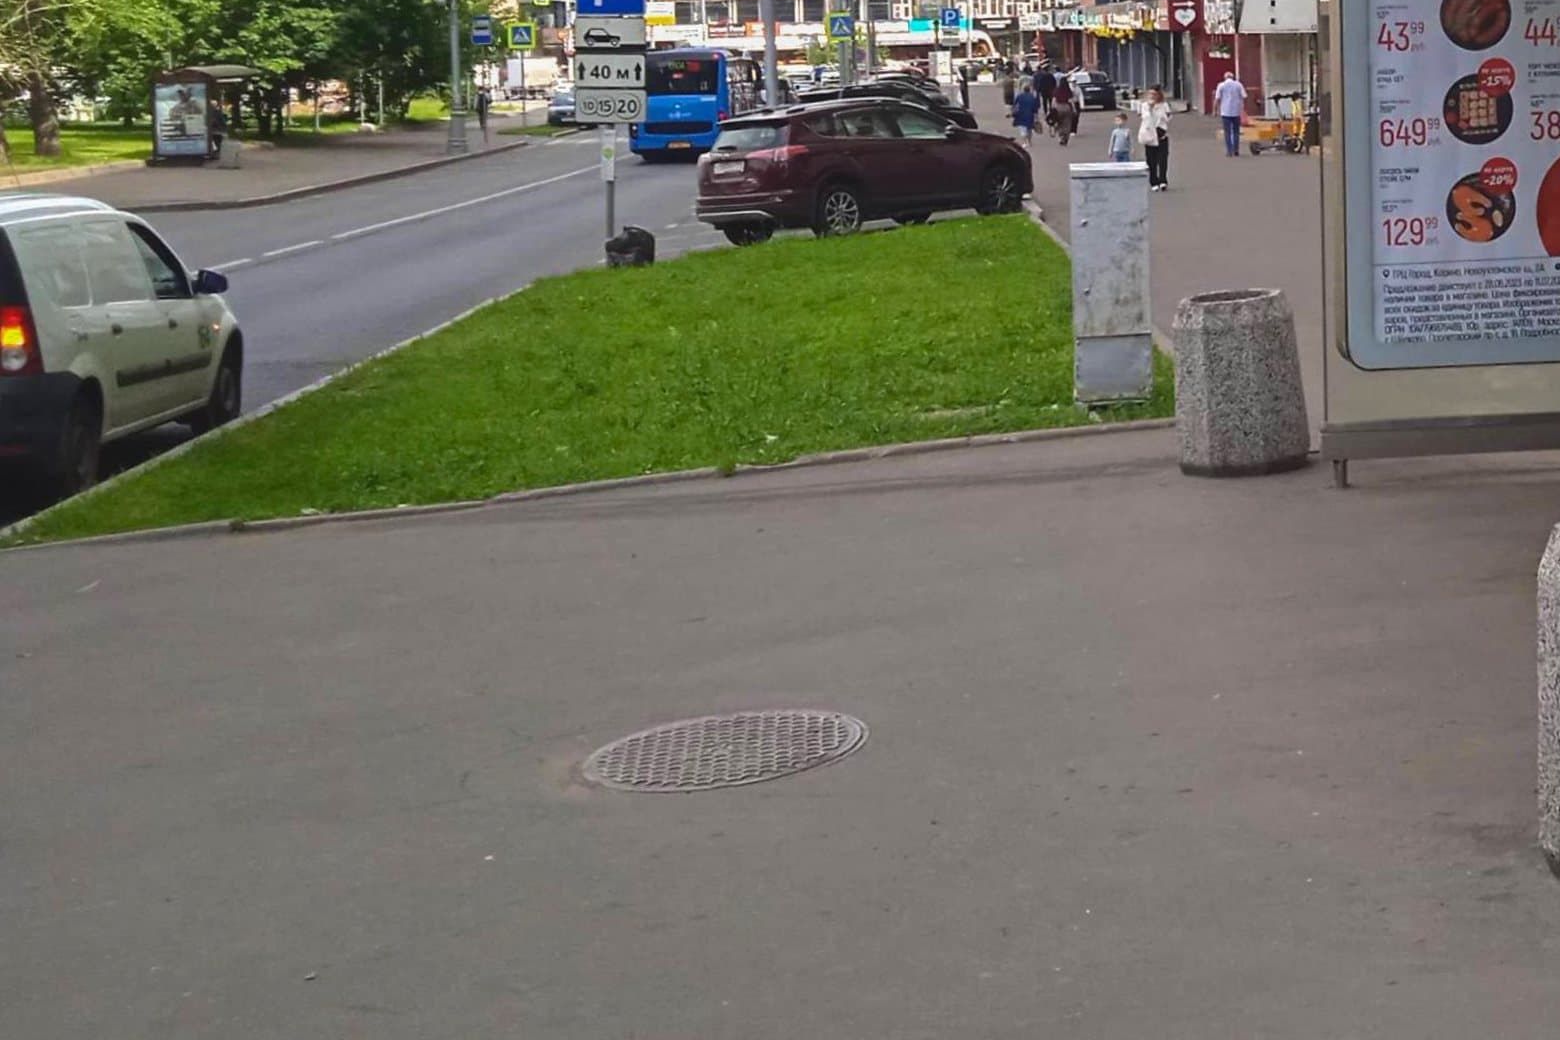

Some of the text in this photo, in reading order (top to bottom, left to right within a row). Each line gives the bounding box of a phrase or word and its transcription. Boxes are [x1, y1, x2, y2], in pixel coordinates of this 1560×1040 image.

[589, 65, 612, 80] 40
[583, 99, 638, 114] 10 15 20
[1383, 218, 1424, 247] 129
